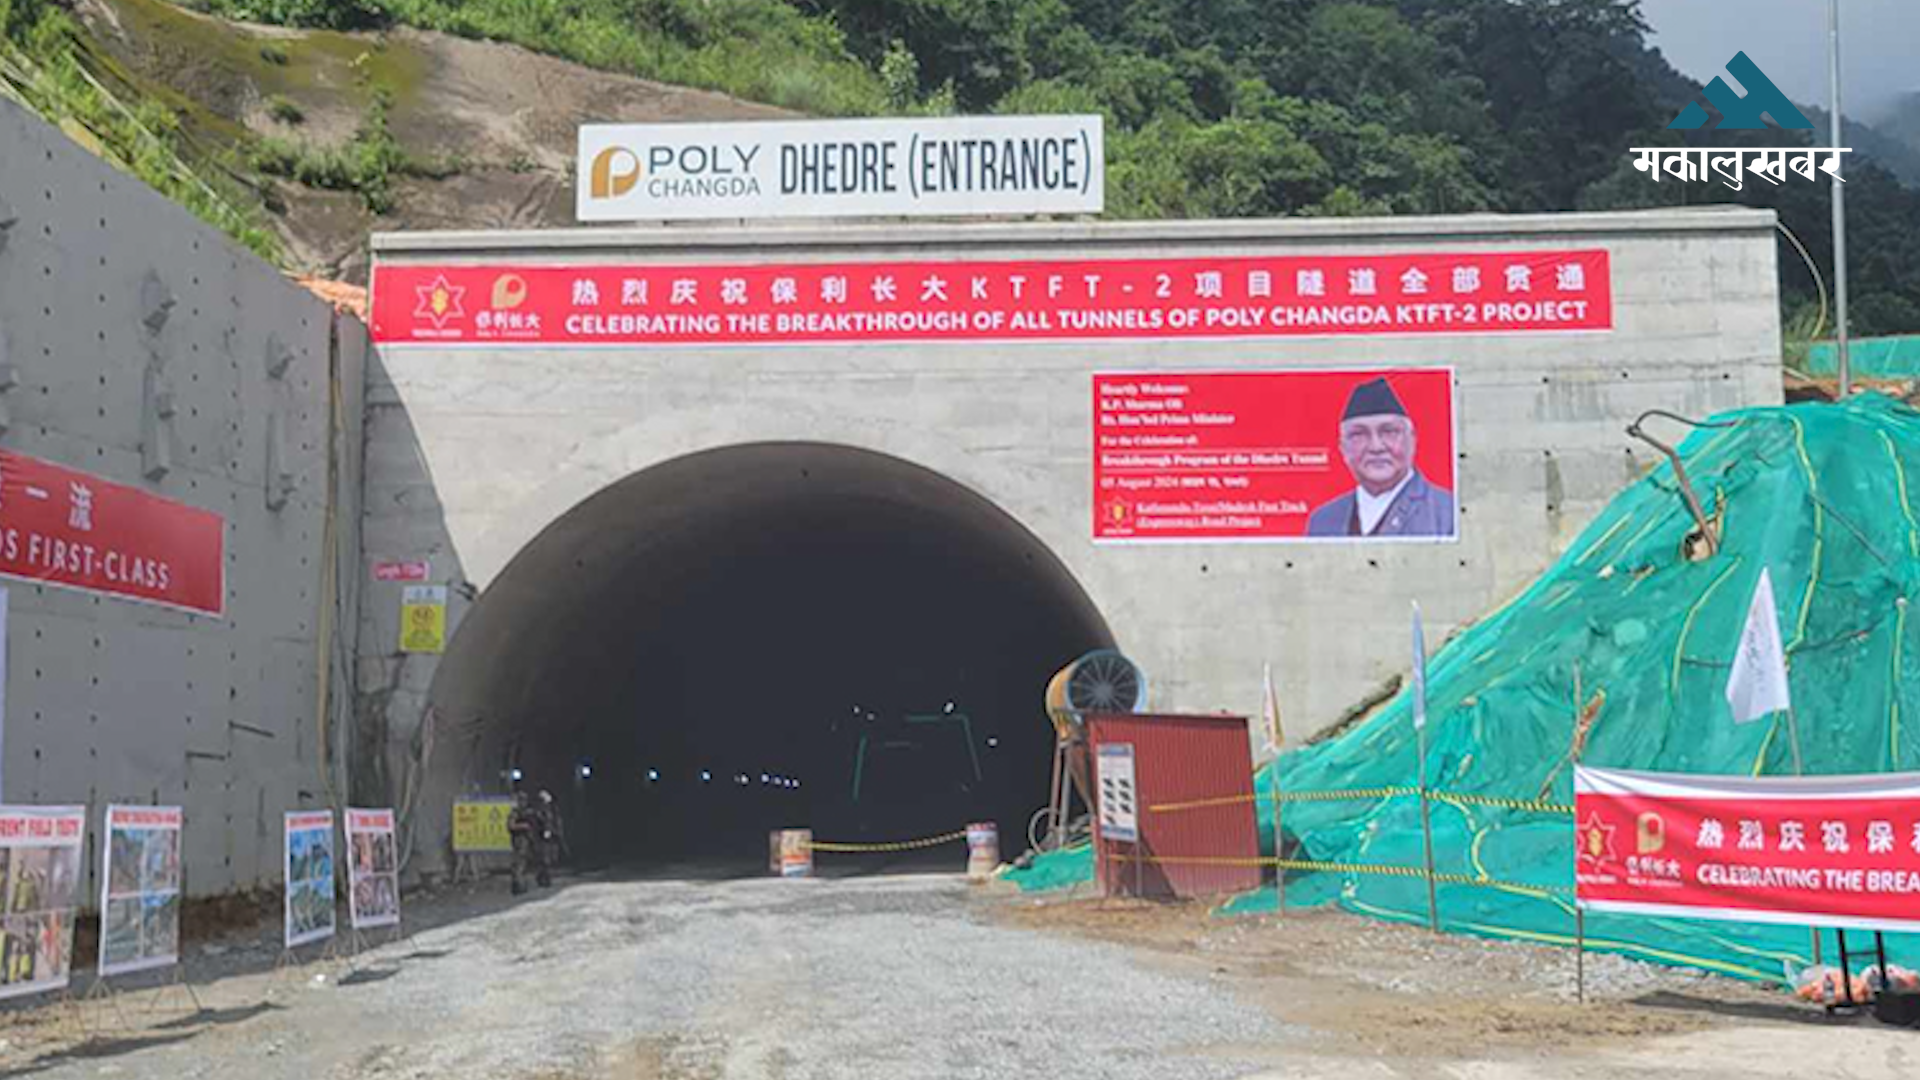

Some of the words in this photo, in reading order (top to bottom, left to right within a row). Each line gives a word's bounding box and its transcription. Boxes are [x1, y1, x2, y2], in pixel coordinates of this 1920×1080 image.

[648, 144, 761, 174] POLY
[780, 141, 896, 195] DHEDRE
[907, 129, 1092, 198] (ENTRANCE)
[648, 177, 761, 198] CHANGDA
[566, 314, 721, 334] CELEBRATING
[727, 314, 770, 333] THE
[776, 311, 967, 333] BREAKTHROUGH
[972, 312, 1004, 330] OF
[1010, 311, 1052, 330] ALL
[1057, 309, 1163, 329] TUNNELS
[1168, 308, 1200, 328] OF
[1206, 308, 1264, 327] POLY
[1270, 305, 1391, 326] CHANGDA
[1396, 303, 1476, 324] KTFT-2
[1483, 301, 1587, 322] PROJECT
[28, 533, 170, 590] FIRST-CLASS
[1697, 864, 1820, 889] CELEBRATING
[1824, 869, 1864, 891] THE
